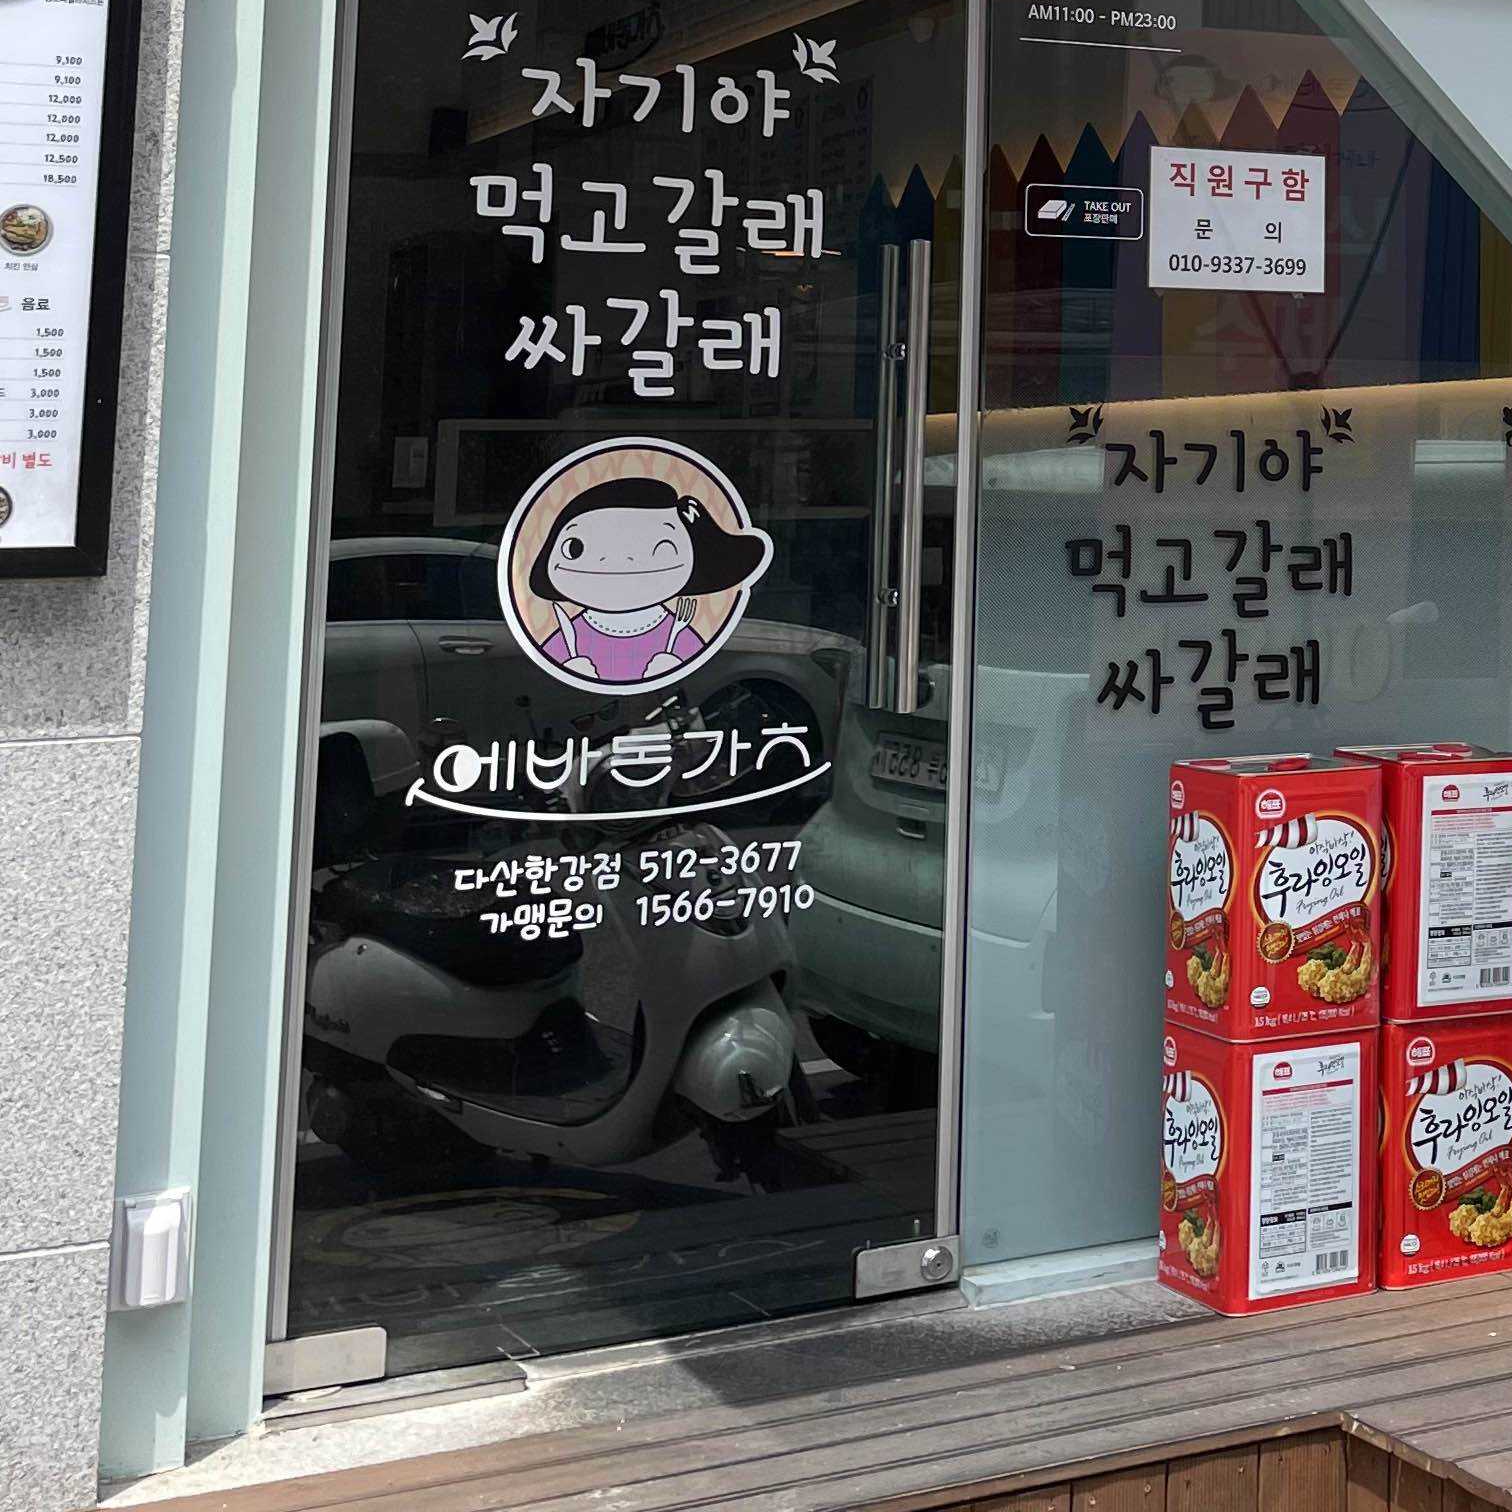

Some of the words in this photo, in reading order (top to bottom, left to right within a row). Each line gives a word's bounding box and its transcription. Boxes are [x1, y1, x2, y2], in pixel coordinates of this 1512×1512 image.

[1028, 4, 1095, 24] AM11:00
[1110, 10, 1177, 31] PM23:00
[521, 57, 792, 138] 자기야
[1084, 200, 1109, 212] TAKE
[1111, 202, 1132, 213] OUT
[1168, 253, 1307, 276] 010-9337-3699
[21, 297, 50, 312] 음료
[504, 289, 781, 397] 싸갈래
[22, 451, 53, 470] 별도
[1105, 429, 1324, 493] 자기야
[1098, 628, 1321, 730] 싸갈래
[454, 852, 622, 898] 다산한강점
[639, 840, 802, 883] 512-3677
[1171, 851, 1226, 908] 후라잉오일
[1262, 843, 1368, 918] 후라잉오일
[1330, 886, 1345, 899] Oil
[480, 898, 603, 941] 가맹문의
[635, 885, 815, 927] 1566-7910
[1165, 1107, 1219, 1169] 후라잉오일
